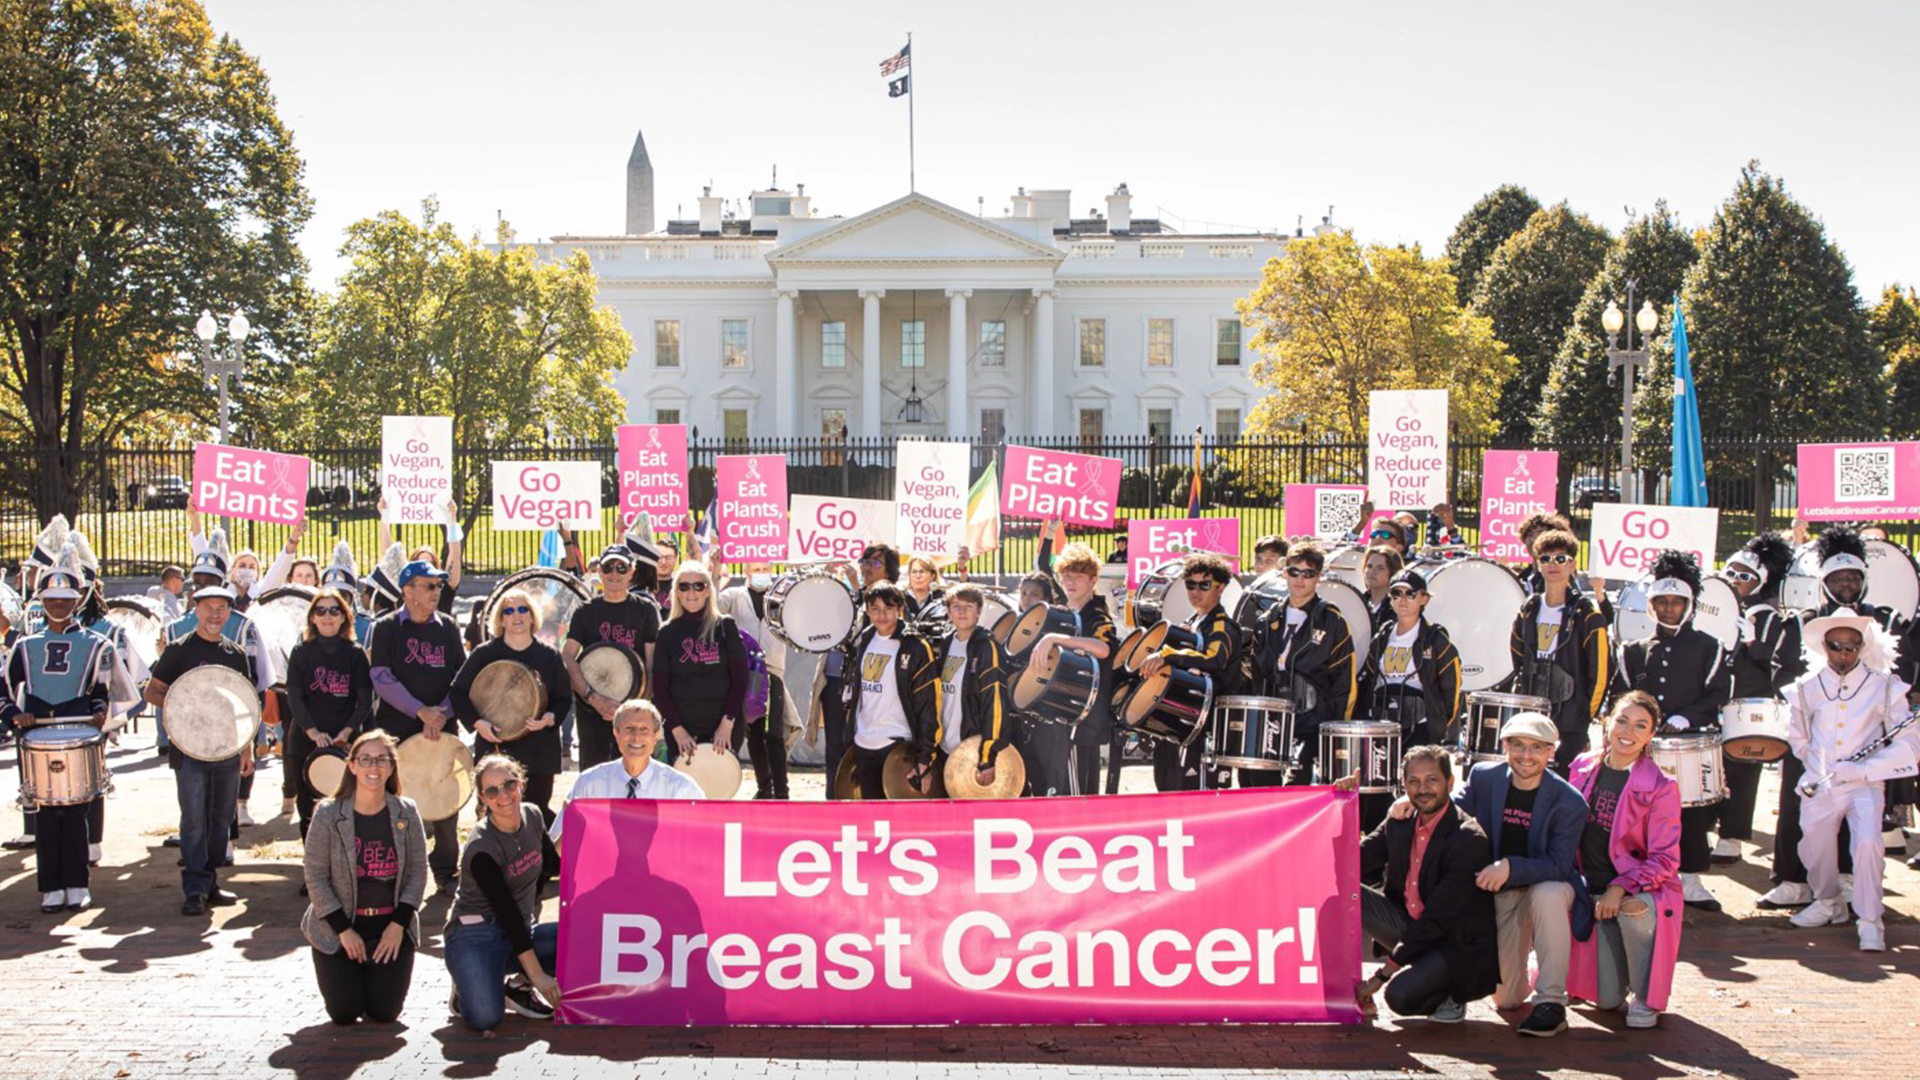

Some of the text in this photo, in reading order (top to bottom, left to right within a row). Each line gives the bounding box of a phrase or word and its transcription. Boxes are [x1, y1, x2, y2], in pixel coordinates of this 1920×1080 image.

[1395, 416, 1422, 432] Go
[405, 439, 429, 453] Go
[1377, 432, 1439, 452] Vegan,
[389, 454, 445, 471] Vegan,
[639, 450, 668, 467] Eat
[1374, 455, 1442, 471] Reduce
[215, 451, 266, 486] Eat
[920, 466, 945, 481] Go
[1025, 455, 1078, 486] Eat
[387, 474, 448, 489] Reduce
[519, 466, 561, 492] Go
[624, 470, 683, 489] Plants,
[738, 480, 768, 497] Eat
[1386, 473, 1430, 488] Your
[1504, 477, 1535, 495] Eat
[398, 491, 436, 504] Your
[627, 489, 681, 508] Crush
[903, 481, 960, 500] Vegan,
[1389, 490, 1426, 506] Risk
[199, 480, 299, 521] Plants
[723, 500, 783, 519] Plants,
[1007, 483, 1109, 522] Plants
[401, 506, 433, 520] Risk
[500, 494, 592, 527] Vegan
[623, 510, 687, 528] Cncer
[816, 502, 857, 531] Go
[900, 503, 963, 520] Reduce
[726, 519, 781, 539] Crush
[911, 520, 951, 536] Your
[1489, 518, 1518, 537] Cru
[1622, 510, 1670, 540] Go
[796, 528, 871, 559] Vega
[913, 536, 947, 552] Risk
[1148, 525, 1198, 553] Eat
[1482, 539, 1530, 557] Canc
[723, 541, 786, 559] Cancer
[1598, 539, 1704, 573] Veg
[808, 633, 832, 643] EVANS
[42, 639, 72, 675] E
[1384, 646, 1413, 673] W
[862, 652, 892, 683] W
[1267, 717, 1280, 756] Pearl
[1372, 740, 1387, 781] Pearl
[1595, 796, 1617, 816] BE
[363, 847, 397, 864] BEA
[724, 818, 1197, 898] Let's Beat
[601, 907, 1319, 991] Breast Cancer!
